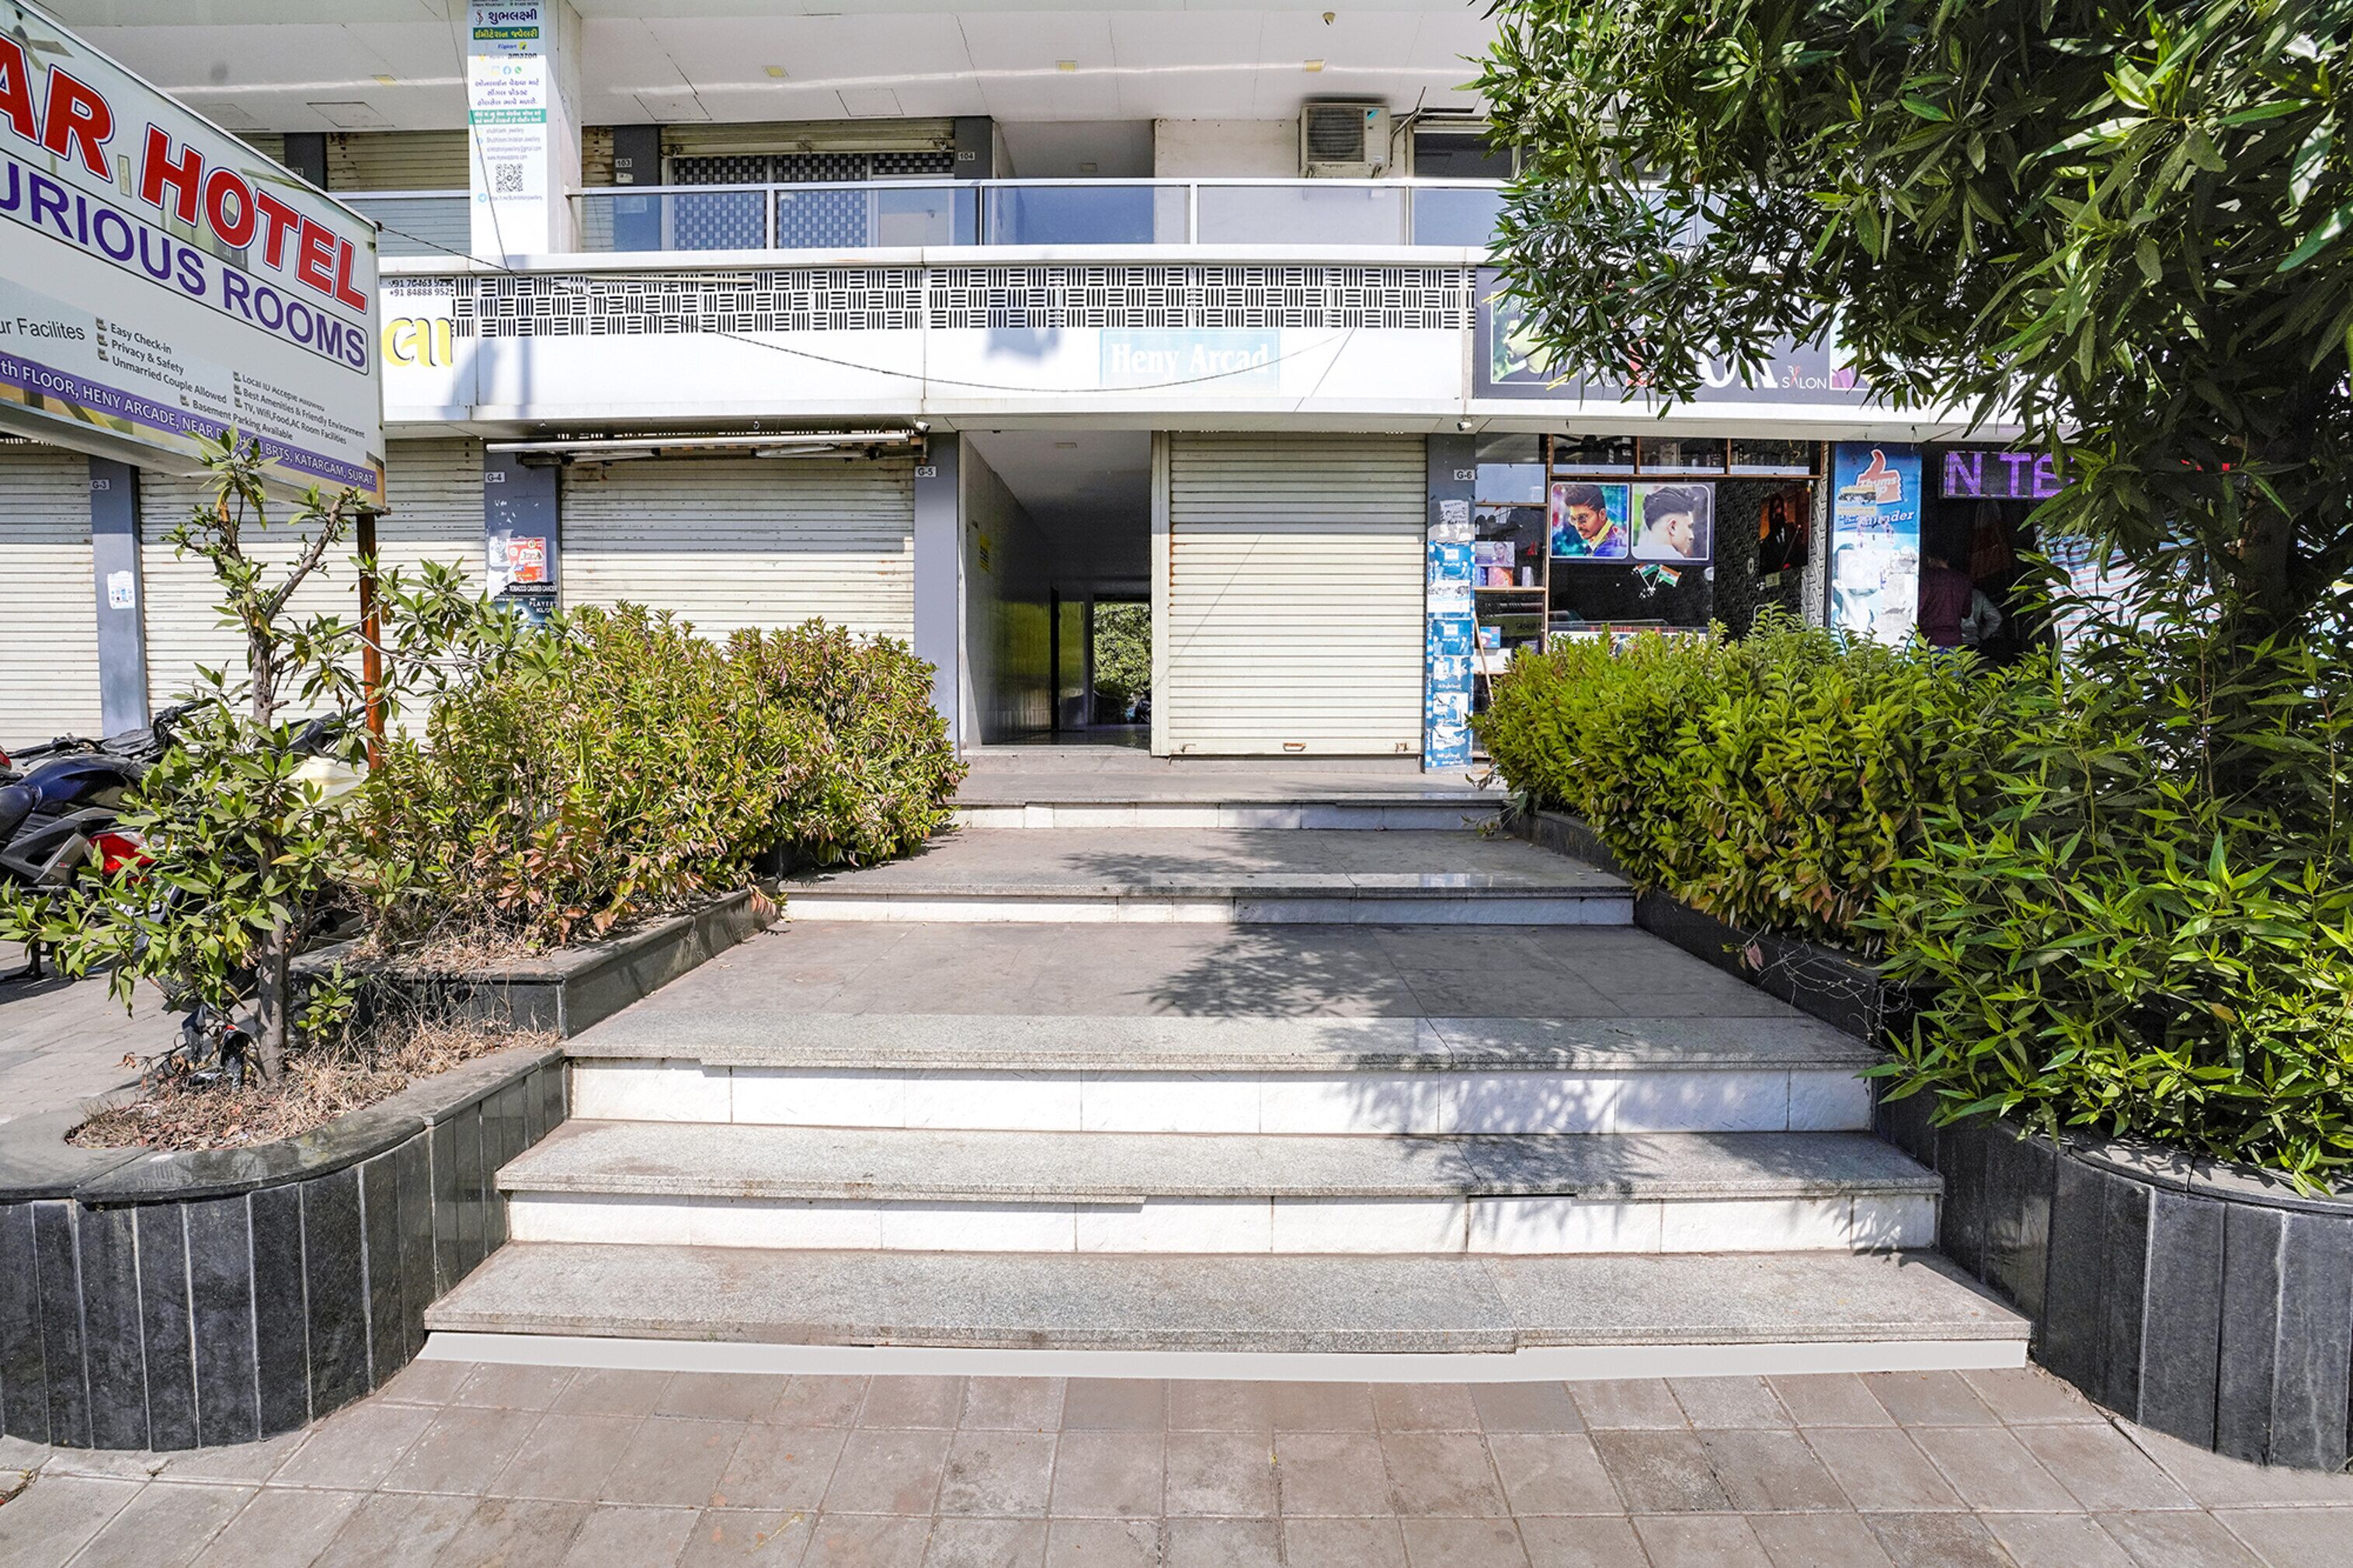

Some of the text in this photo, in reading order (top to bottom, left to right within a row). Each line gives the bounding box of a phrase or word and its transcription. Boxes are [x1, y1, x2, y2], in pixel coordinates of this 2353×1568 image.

[139, 122, 368, 315] HOTEL
[0, 162, 366, 368] URIOUS ROOMS
[406, 288, 433, 297] 84888
[16, 317, 85, 341] Facilites
[110, 323, 172, 355] Easy Check-in
[111, 339, 184, 376] Privacy & Safety
[1110, 342, 1269, 379] Heny Arcad
[113, 355, 228, 405] Unmarried Couple Allowed
[242, 374, 262, 389] Local
[23, 365, 80, 400] FLOOR,
[83, 384, 122, 410] HENY
[124, 399, 179, 430] ARCADE,
[182, 416, 214, 438] NEAR
[265, 443, 293, 464] BRTS,
[294, 451, 346, 479] KATARGAM,
[347, 468, 376, 487] SURAT.
[192, 399, 294, 440] Basement Parking Available
[243, 388, 367, 440] Best Amenities & Friendly Environment
[301, 423, 321, 438] Room
[321, 429, 348, 445] Facilities
[92, 480, 107, 489] G-3
[487, 473, 502, 482] G-4
[917, 468, 933, 476] G-5
[1456, 470, 1472, 479] G-6
[1948, 452, 2075, 498] N TE
